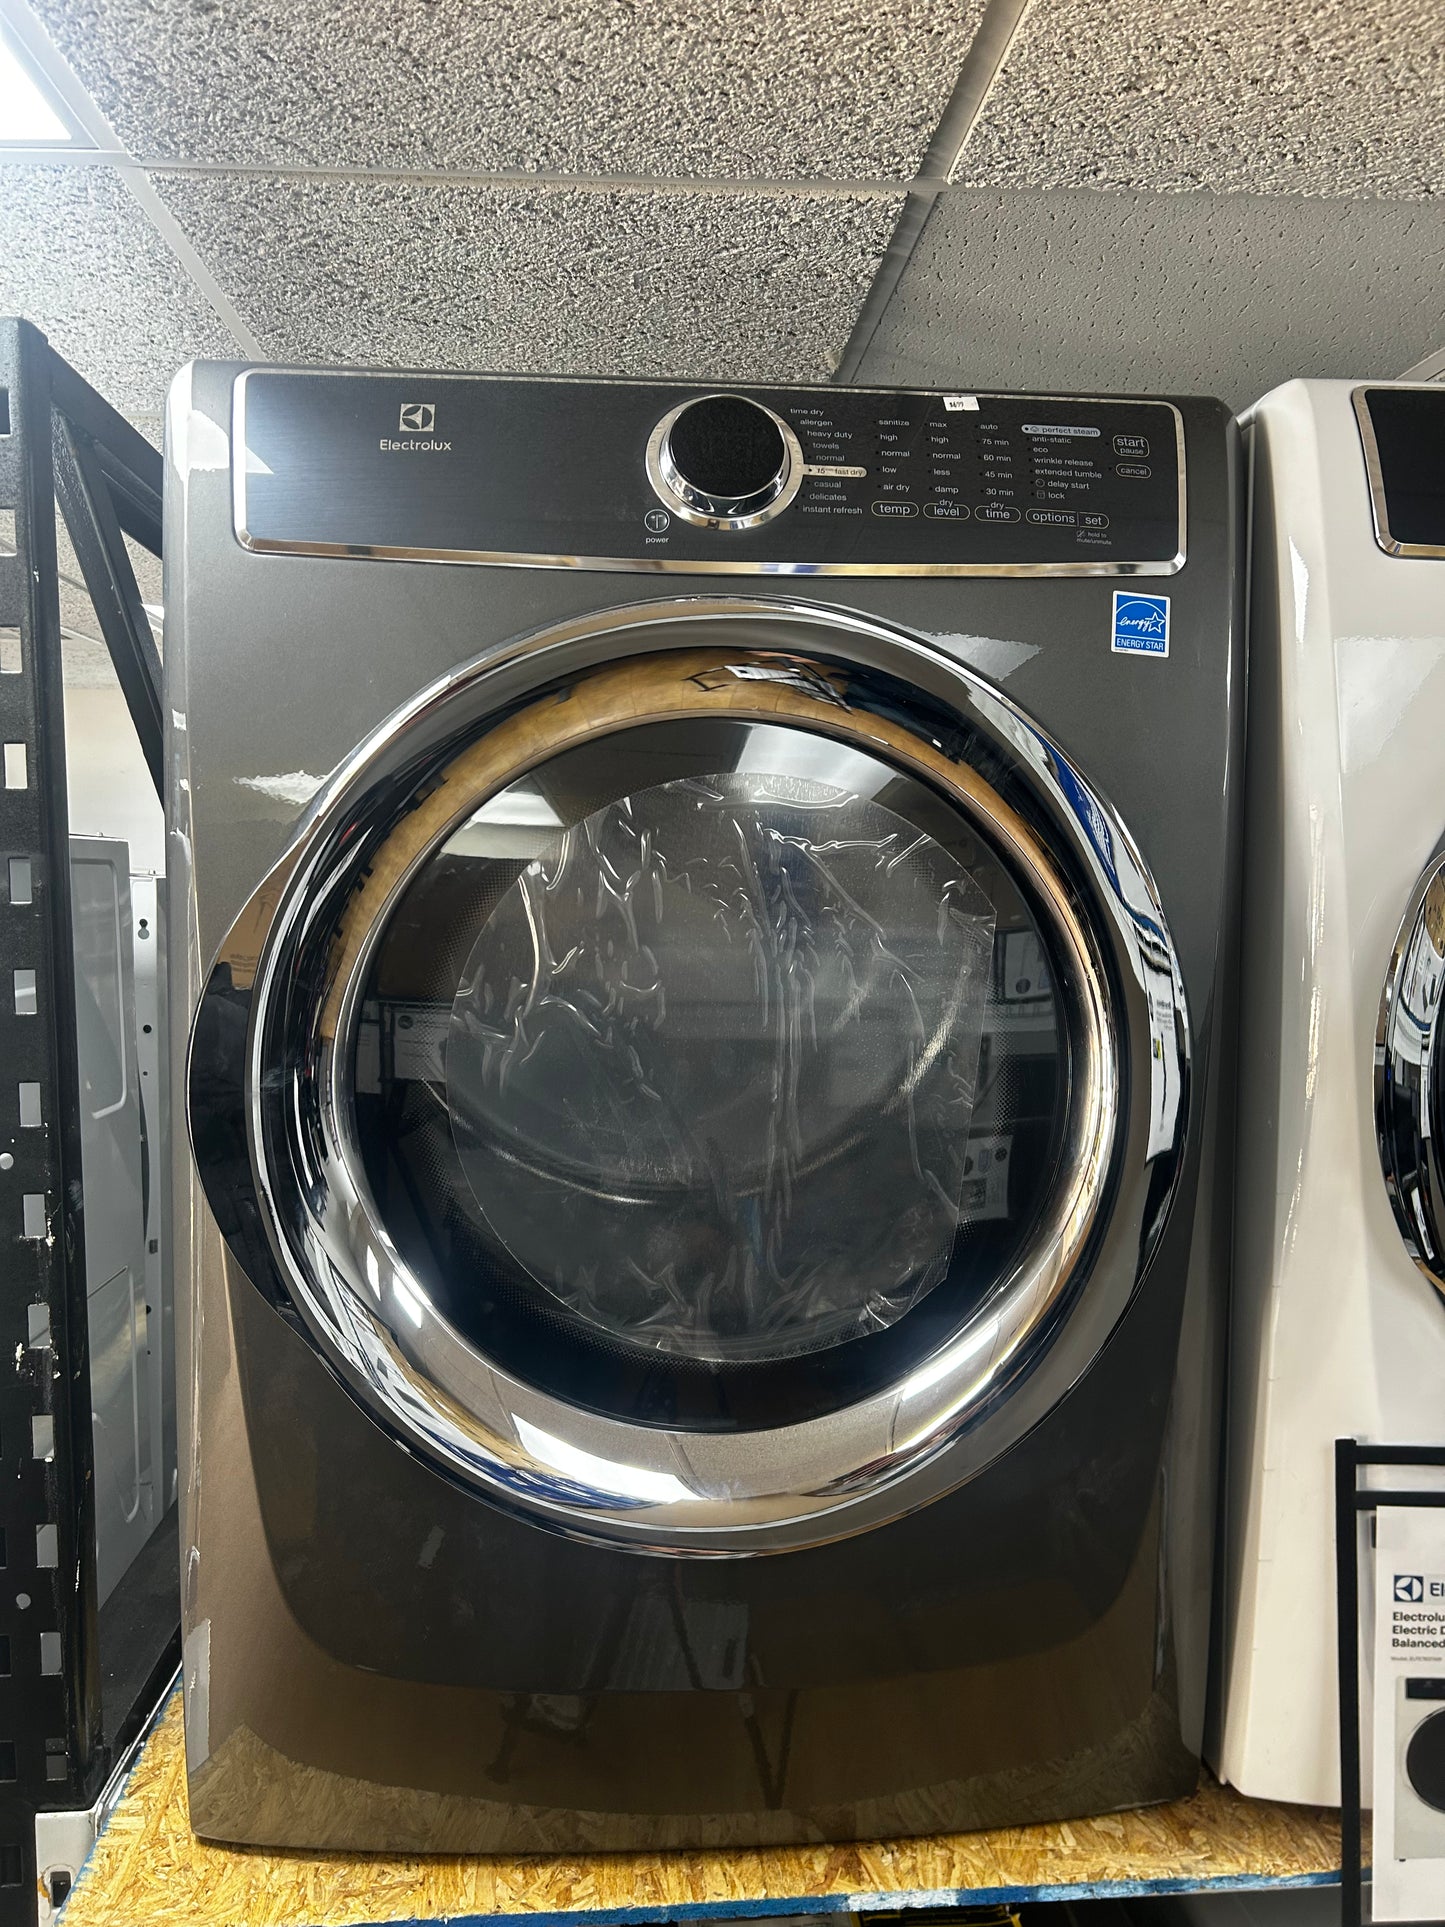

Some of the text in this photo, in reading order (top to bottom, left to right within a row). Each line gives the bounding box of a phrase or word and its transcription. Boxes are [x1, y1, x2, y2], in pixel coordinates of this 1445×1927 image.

[810, 409, 824, 417] dry
[800, 419, 833, 427] allergen
[807, 430, 853, 439] heavy duty
[1042, 426, 1099, 436] perfect steam
[880, 433, 898, 441] high
[931, 436, 949, 444] high
[1031, 436, 1072, 444] anti-static
[379, 439, 452, 451] Electrolux
[994, 438, 1009, 446] min
[1117, 436, 1145, 448] start
[932, 452, 961, 460] normal
[1120, 448, 1144, 456] pause
[996, 454, 1011, 462] min
[1033, 457, 1094, 467] wrinkle release
[933, 468, 951, 476] less
[997, 471, 1013, 479] min
[1035, 468, 1102, 479] extended tumble
[1120, 467, 1147, 476] cancel
[883, 483, 910, 492] air dry
[1047, 480, 1090, 490] delay start
[934, 485, 959, 495] damp
[985, 488, 1014, 497] 30 min
[809, 493, 847, 501] delicates
[1048, 491, 1065, 499] lock
[939, 499, 953, 507] dry
[990, 501, 1004, 510] dry
[803, 505, 863, 514] instant refresh
[880, 504, 911, 515] temp
[934, 506, 960, 516] level
[985, 508, 1010, 519] time
[1032, 511, 1075, 524] options
[1085, 515, 1103, 525] set
[1116, 637, 1164, 651] ENERGY STAR
[1392, 1625, 1437, 1635] Electric
[1391, 1638, 1445, 1648] Balanced
